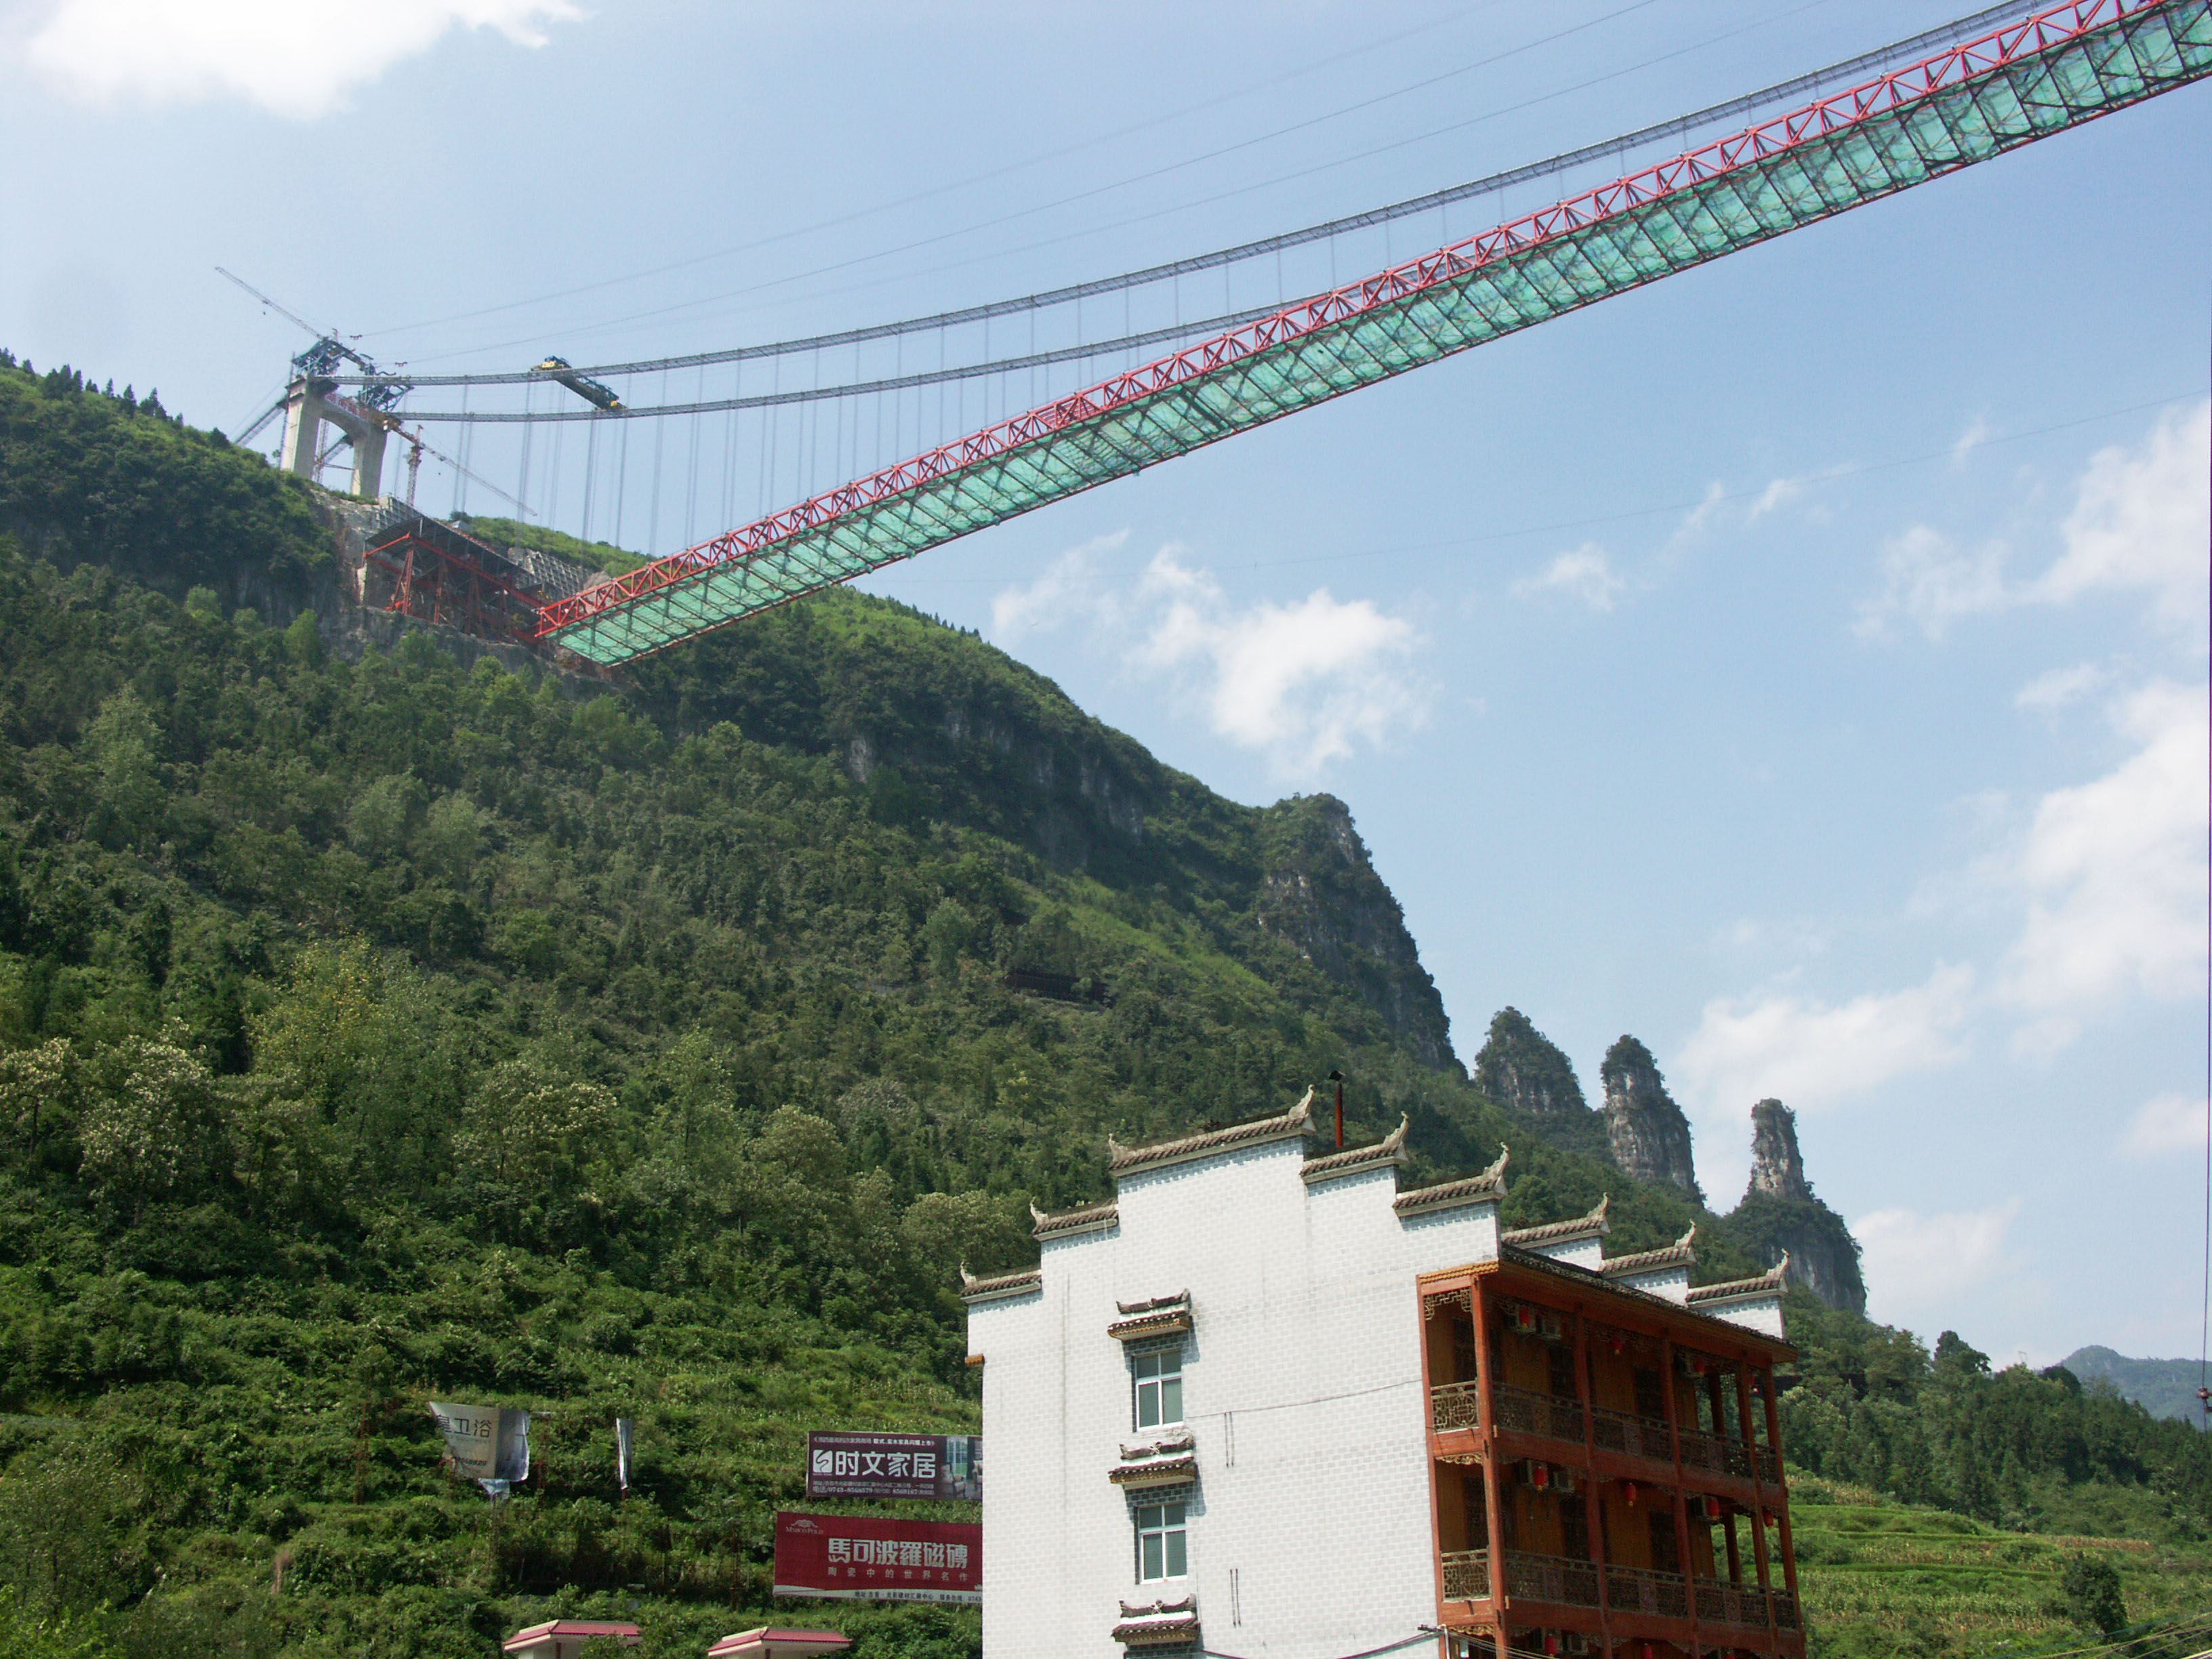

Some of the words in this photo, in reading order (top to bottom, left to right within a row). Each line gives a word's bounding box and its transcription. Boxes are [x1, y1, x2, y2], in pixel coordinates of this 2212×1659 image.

[836, 1450, 936, 1479] 时文家居
[829, 1538, 968, 1569] 馬可波羅磁磚
